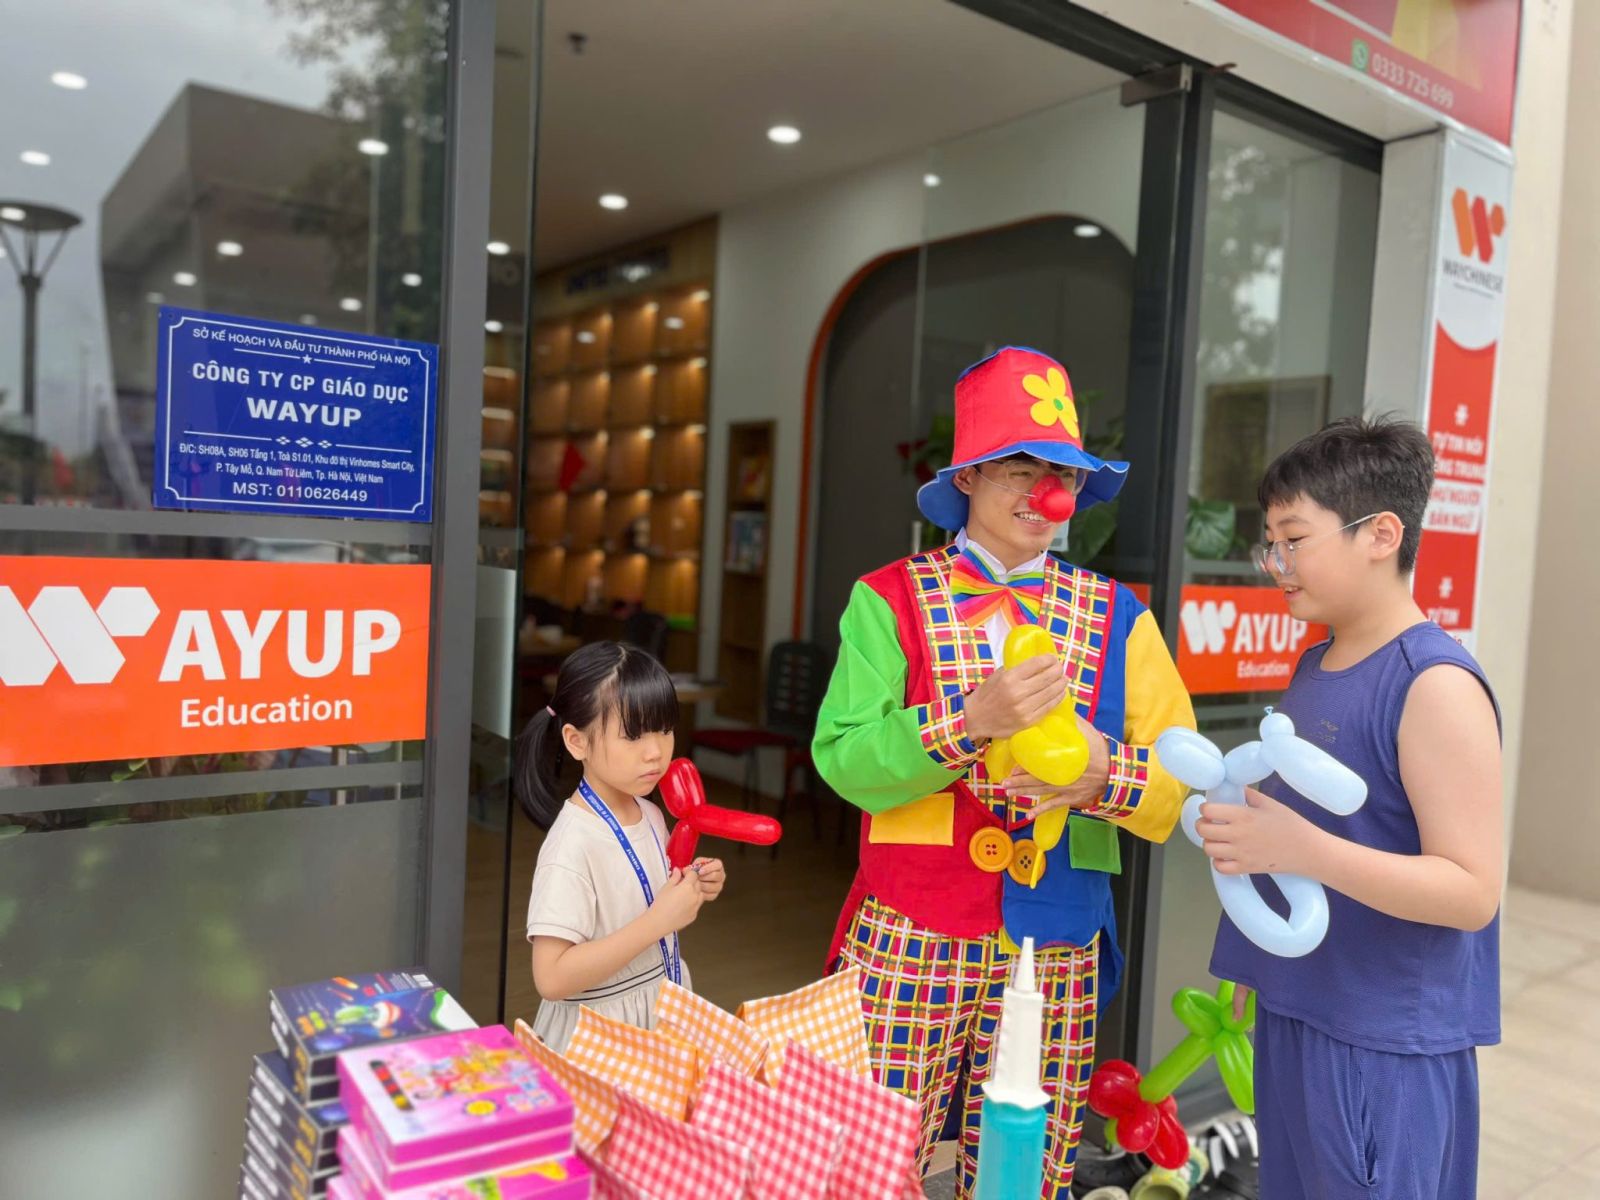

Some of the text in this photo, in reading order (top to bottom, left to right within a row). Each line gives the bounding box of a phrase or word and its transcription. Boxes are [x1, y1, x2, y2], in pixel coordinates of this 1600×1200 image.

[193, 326, 209, 339] SỞ
[211, 329, 227, 341] KẾ
[228, 333, 266, 347] HOẠCH
[267, 337, 283, 349] VÀ
[308, 343, 322, 354] TƯ
[323, 345, 356, 359] THÀNH
[357, 350, 378, 362] PHỐ
[379, 352, 393, 363] HÀ
[394, 354, 411, 366] NỘI
[192, 360, 409, 405] CÔNG TY CP GIÁO DỤC
[246, 397, 362, 428] WAYUP
[179, 443, 197, 454] Đ/C:
[315, 454, 329, 465] Khu
[349, 457, 380, 469] Vinhomes
[381, 460, 401, 471] Smart
[215, 462, 223, 473] P.
[255, 466, 264, 476] Q.
[266, 467, 283, 477] Nam
[315, 469, 327, 481] Tp.
[368, 474, 384, 484] Nam
[232, 481, 368, 502] MST: 0110626449
[1236, 659, 1291, 679] Education
[180, 694, 353, 728] Education
